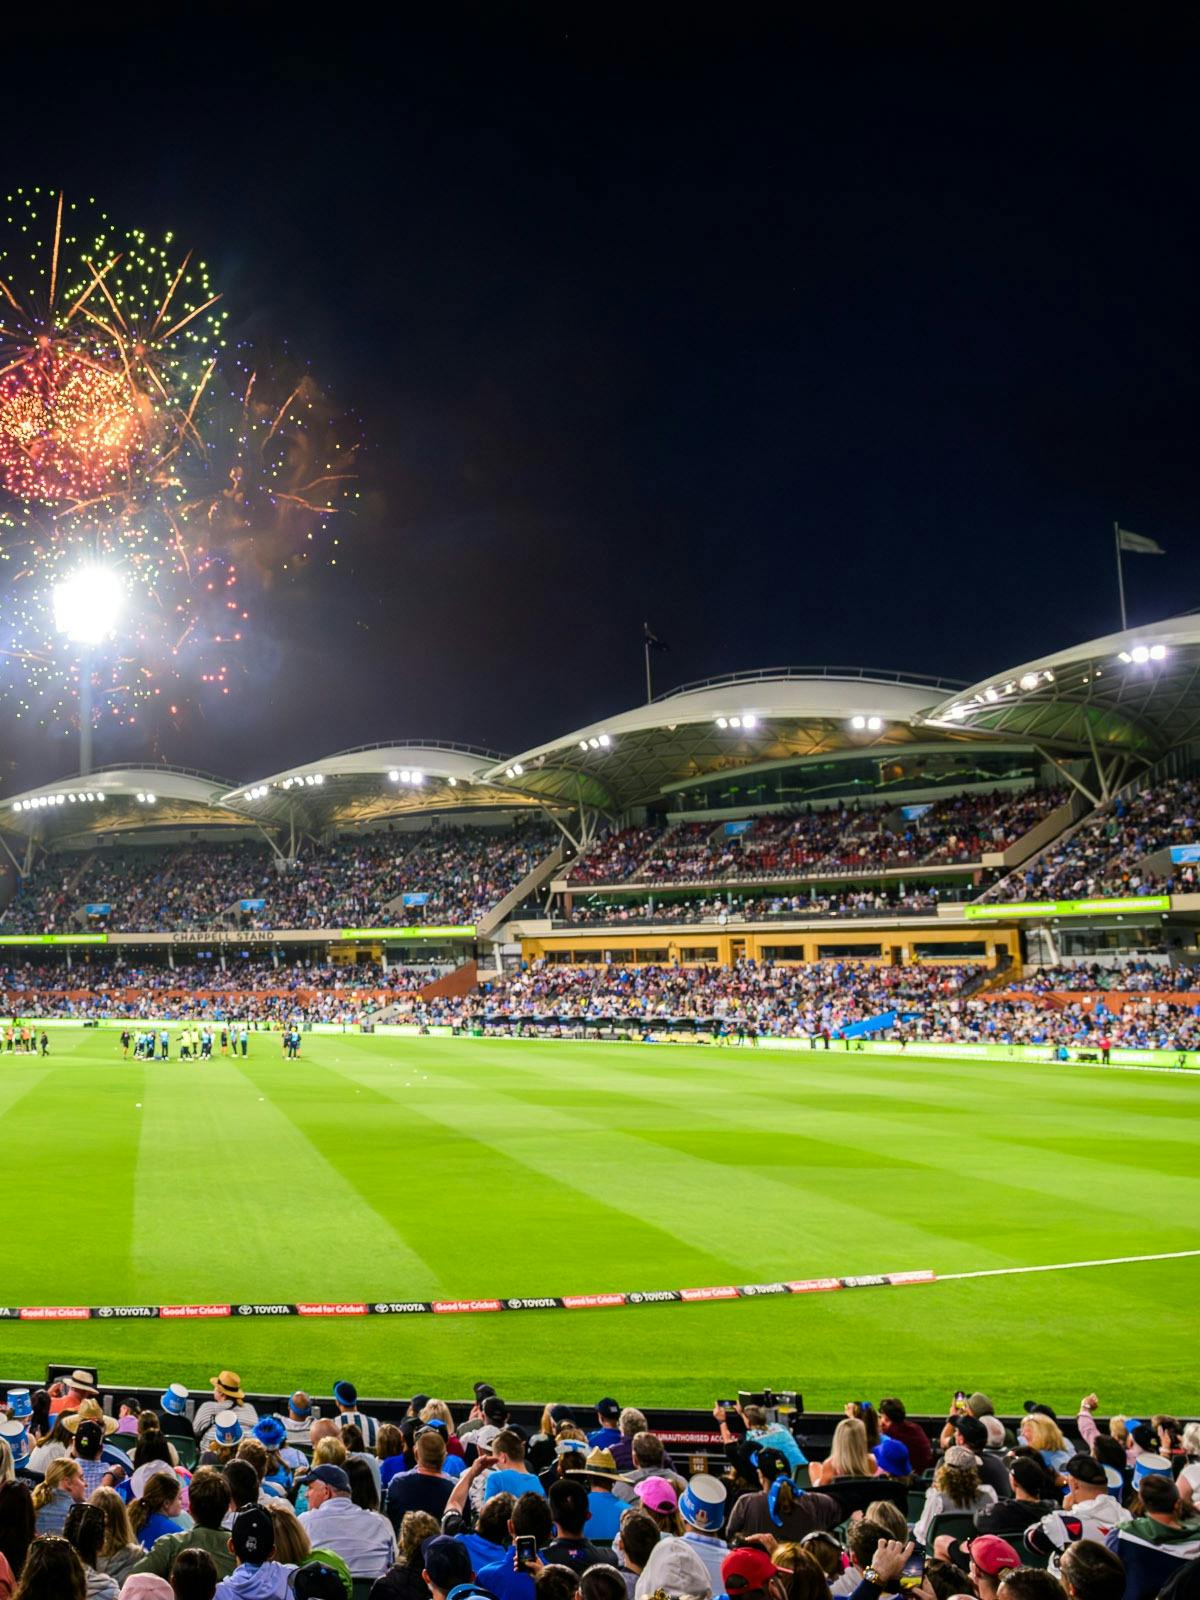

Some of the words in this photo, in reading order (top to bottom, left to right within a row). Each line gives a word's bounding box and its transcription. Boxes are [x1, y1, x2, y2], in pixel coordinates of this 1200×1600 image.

[173, 933, 230, 941] CHAPPELL
[237, 932, 274, 940] STAND
[436, 1303, 458, 1311] Good
[459, 1303, 470, 1312] for
[471, 1302, 498, 1310] Cricket
[522, 1299, 557, 1307] TOYOTA
[114, 1308, 150, 1316] TOYOTA
[162, 1307, 187, 1315] Good
[187, 1307, 198, 1316] for
[199, 1306, 227, 1314] Cricket
[254, 1306, 290, 1314] TOYOTA
[300, 1305, 322, 1313] Good
[322, 1305, 335, 1313] for
[336, 1305, 364, 1313] Cricket
[391, 1304, 426, 1312] TOYOTA
[21, 1308, 43, 1317] Good
[44, 1308, 56, 1317] for
[57, 1308, 87, 1317] Cricket
[658, 1433, 710, 1442] UNAUTHORISED
